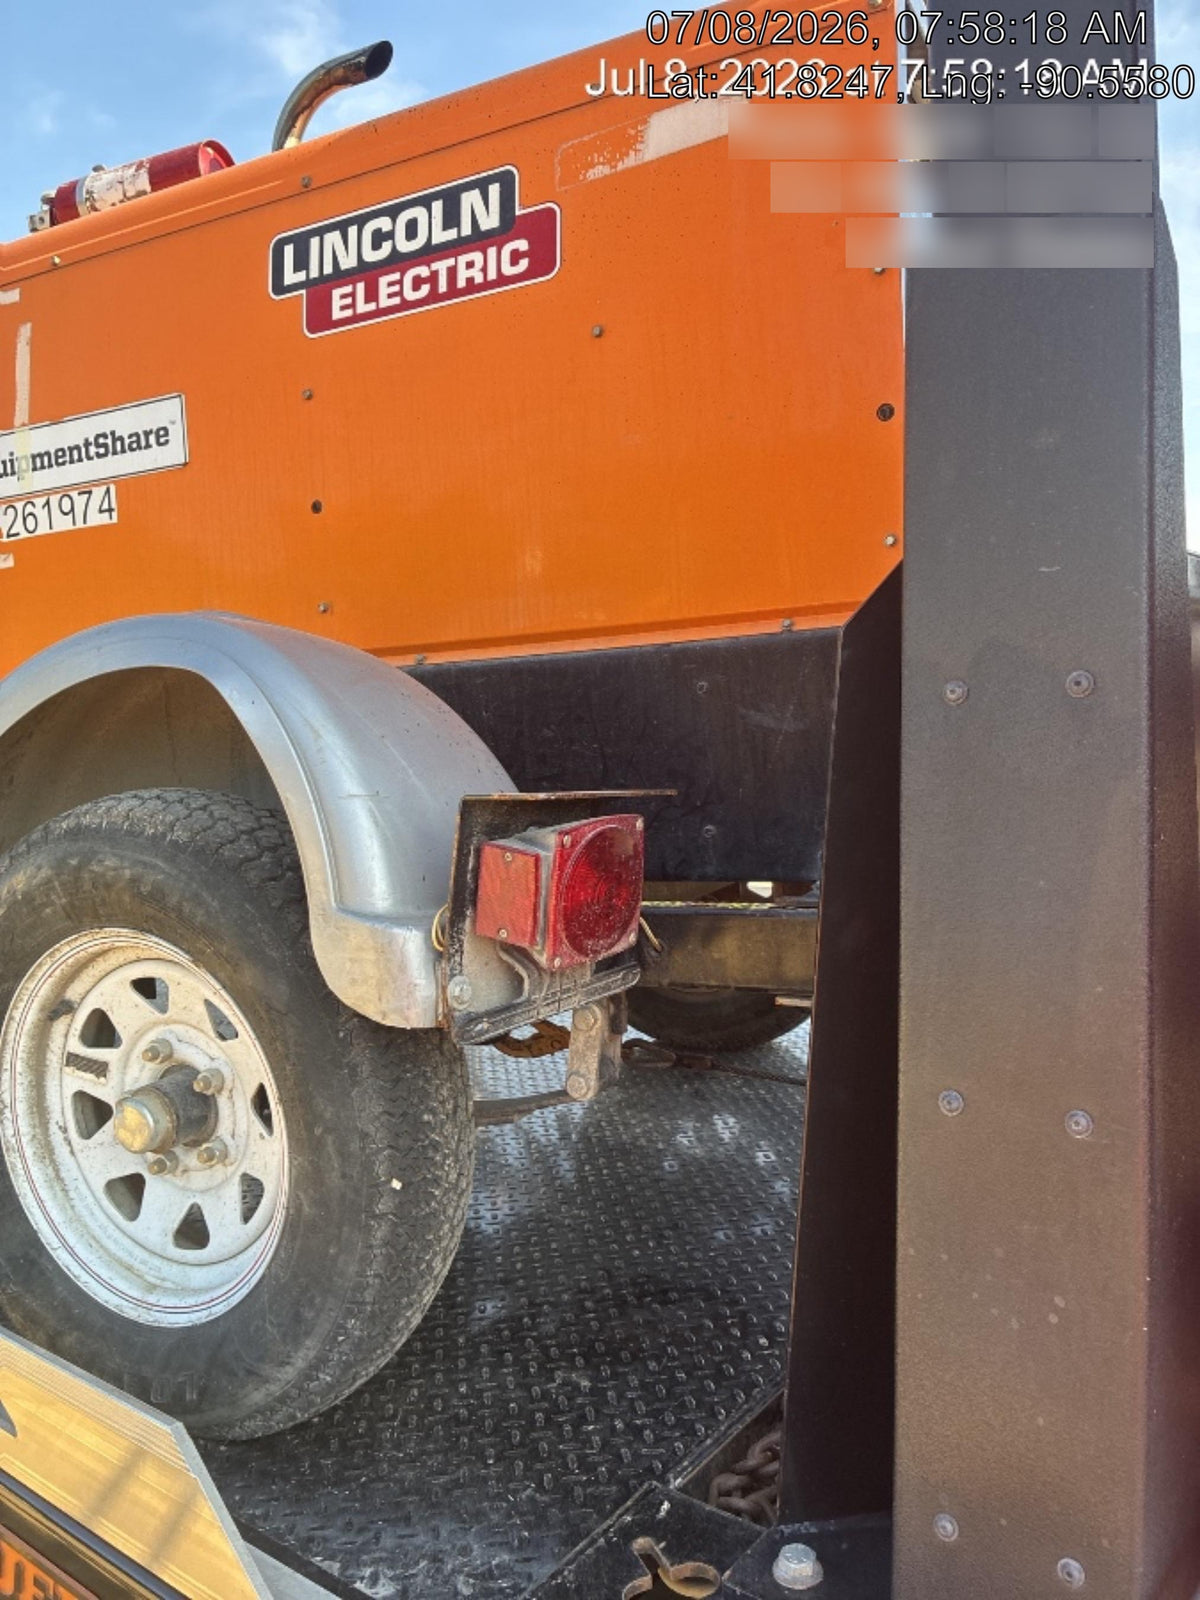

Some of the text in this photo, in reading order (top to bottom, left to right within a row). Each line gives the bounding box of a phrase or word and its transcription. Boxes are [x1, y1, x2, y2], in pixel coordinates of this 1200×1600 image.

[283, 182, 501, 286] LINCOLN
[331, 238, 530, 321] ELECTRIC
[2, 486, 116, 539] 261974
